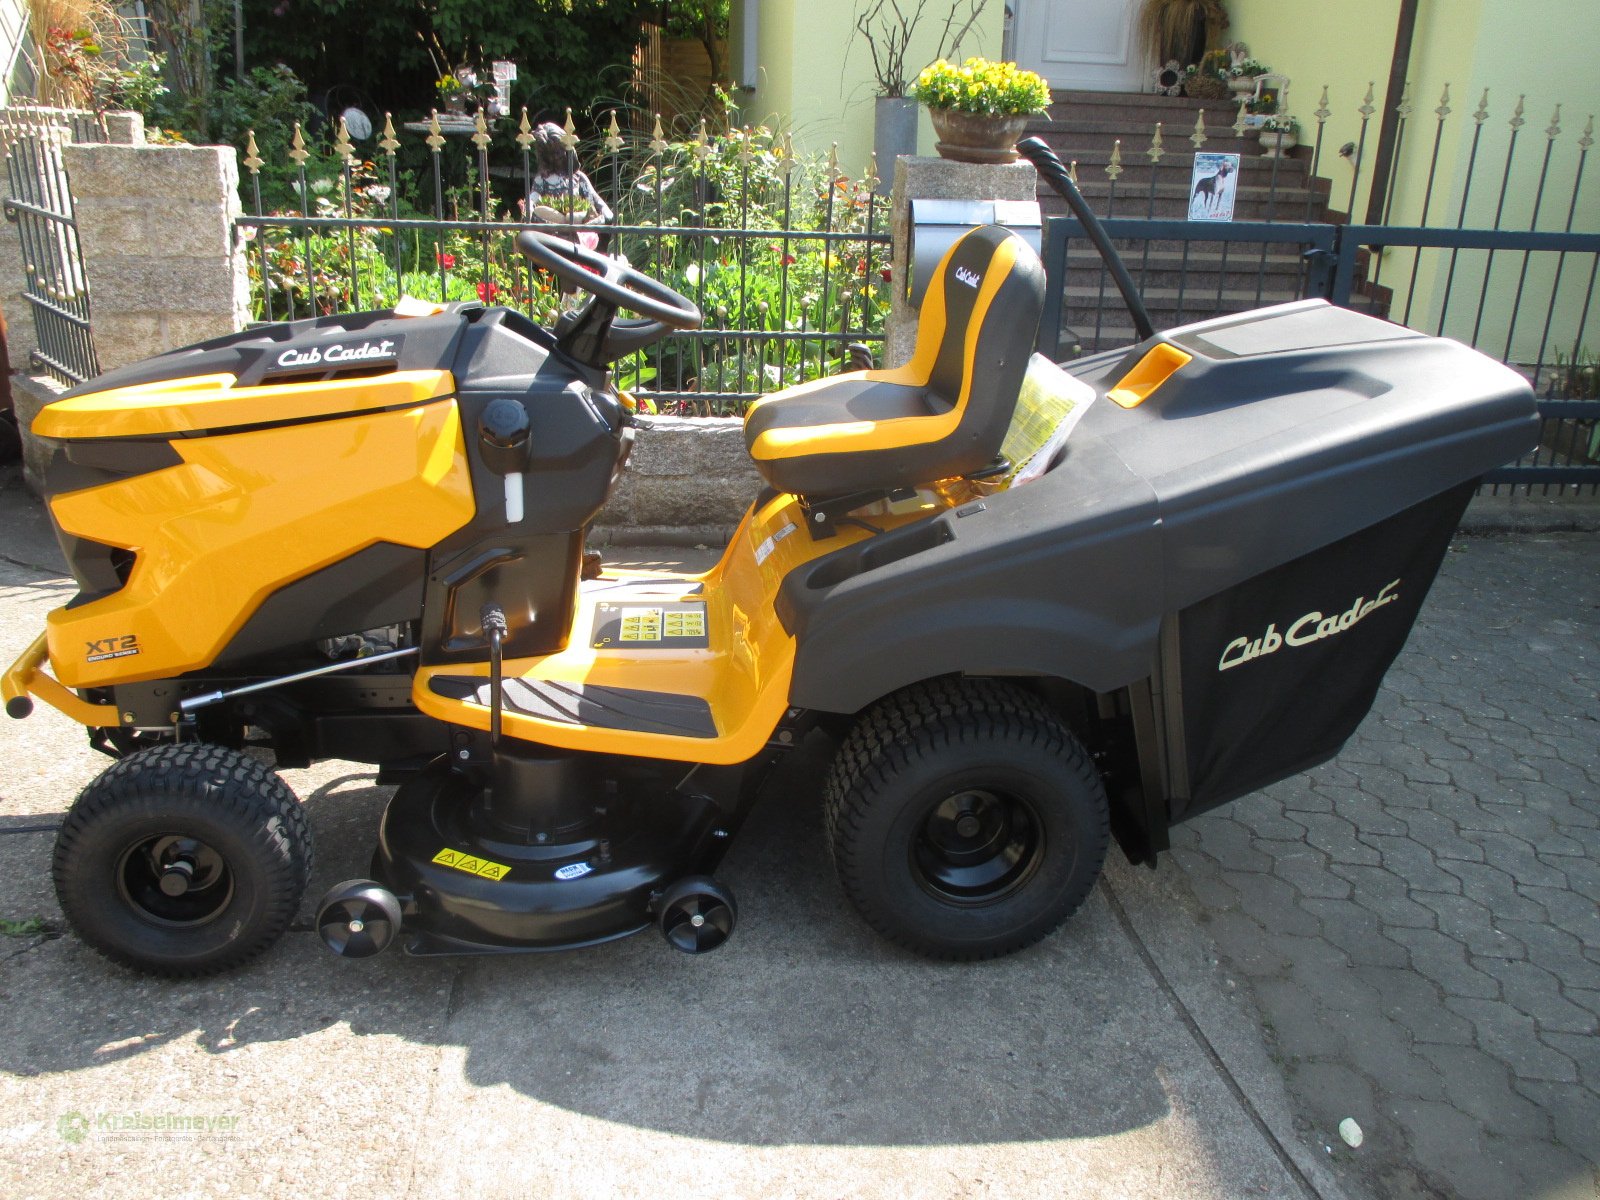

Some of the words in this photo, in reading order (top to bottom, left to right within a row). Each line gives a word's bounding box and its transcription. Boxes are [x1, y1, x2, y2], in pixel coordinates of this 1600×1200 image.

[277, 347, 322, 366] Cub
[323, 340, 395, 362] Cadet
[85, 634, 138, 655] XT2
[1218, 623, 1283, 671] Cub
